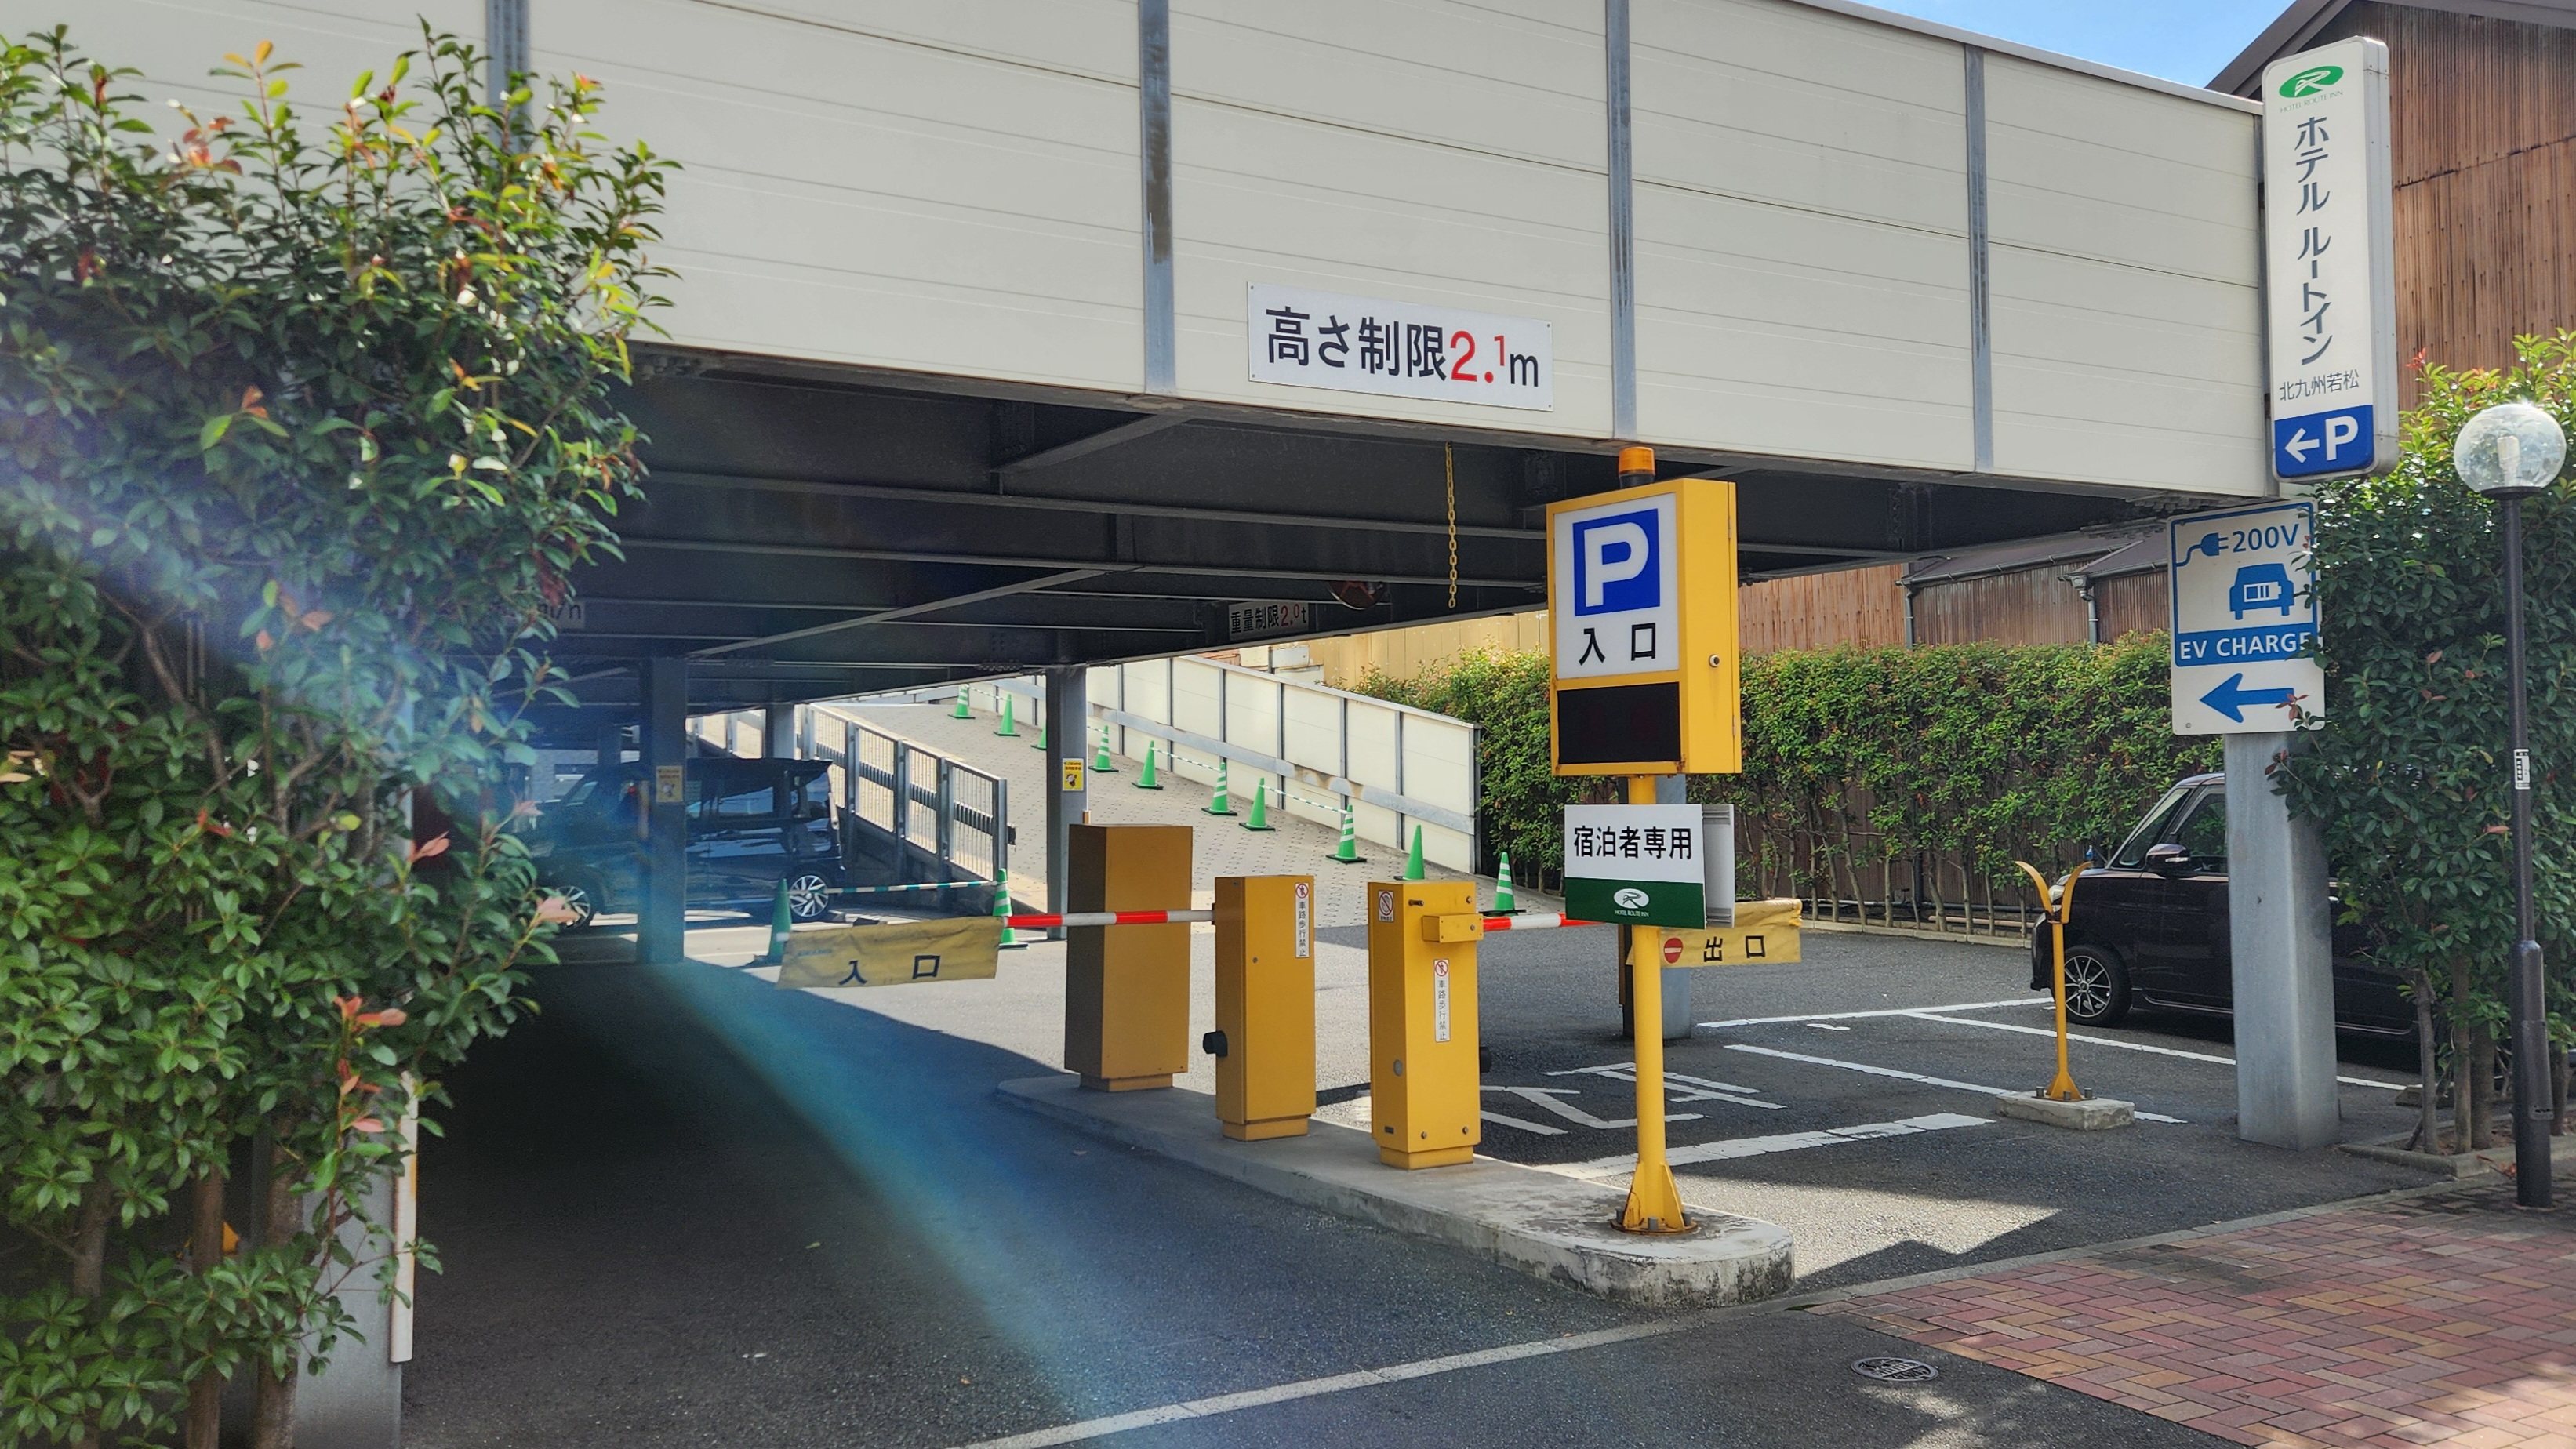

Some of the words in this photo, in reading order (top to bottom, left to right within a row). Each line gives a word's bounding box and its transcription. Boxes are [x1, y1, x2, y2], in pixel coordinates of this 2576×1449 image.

[2294, 116, 2330, 216] ホテル
[2297, 226, 2333, 366] ルートイン
[2279, 369, 2360, 401] 北九州若松
[2325, 416, 2359, 461] P
[2233, 524, 2299, 553] 200V
[1584, 521, 1649, 608] P
[1230, 603, 1307, 634] 重量制限2.0t
[1579, 623, 1656, 666] 入口
[2180, 640, 2207, 659] EV
[1574, 825, 1691, 860] 宿泊者専用
[1298, 901, 1306, 957] 車路歩行禁止
[1703, 935, 1766, 963] 出口
[838, 954, 941, 986] 入口
[1438, 979, 1447, 1040] 車路歩行禁止
